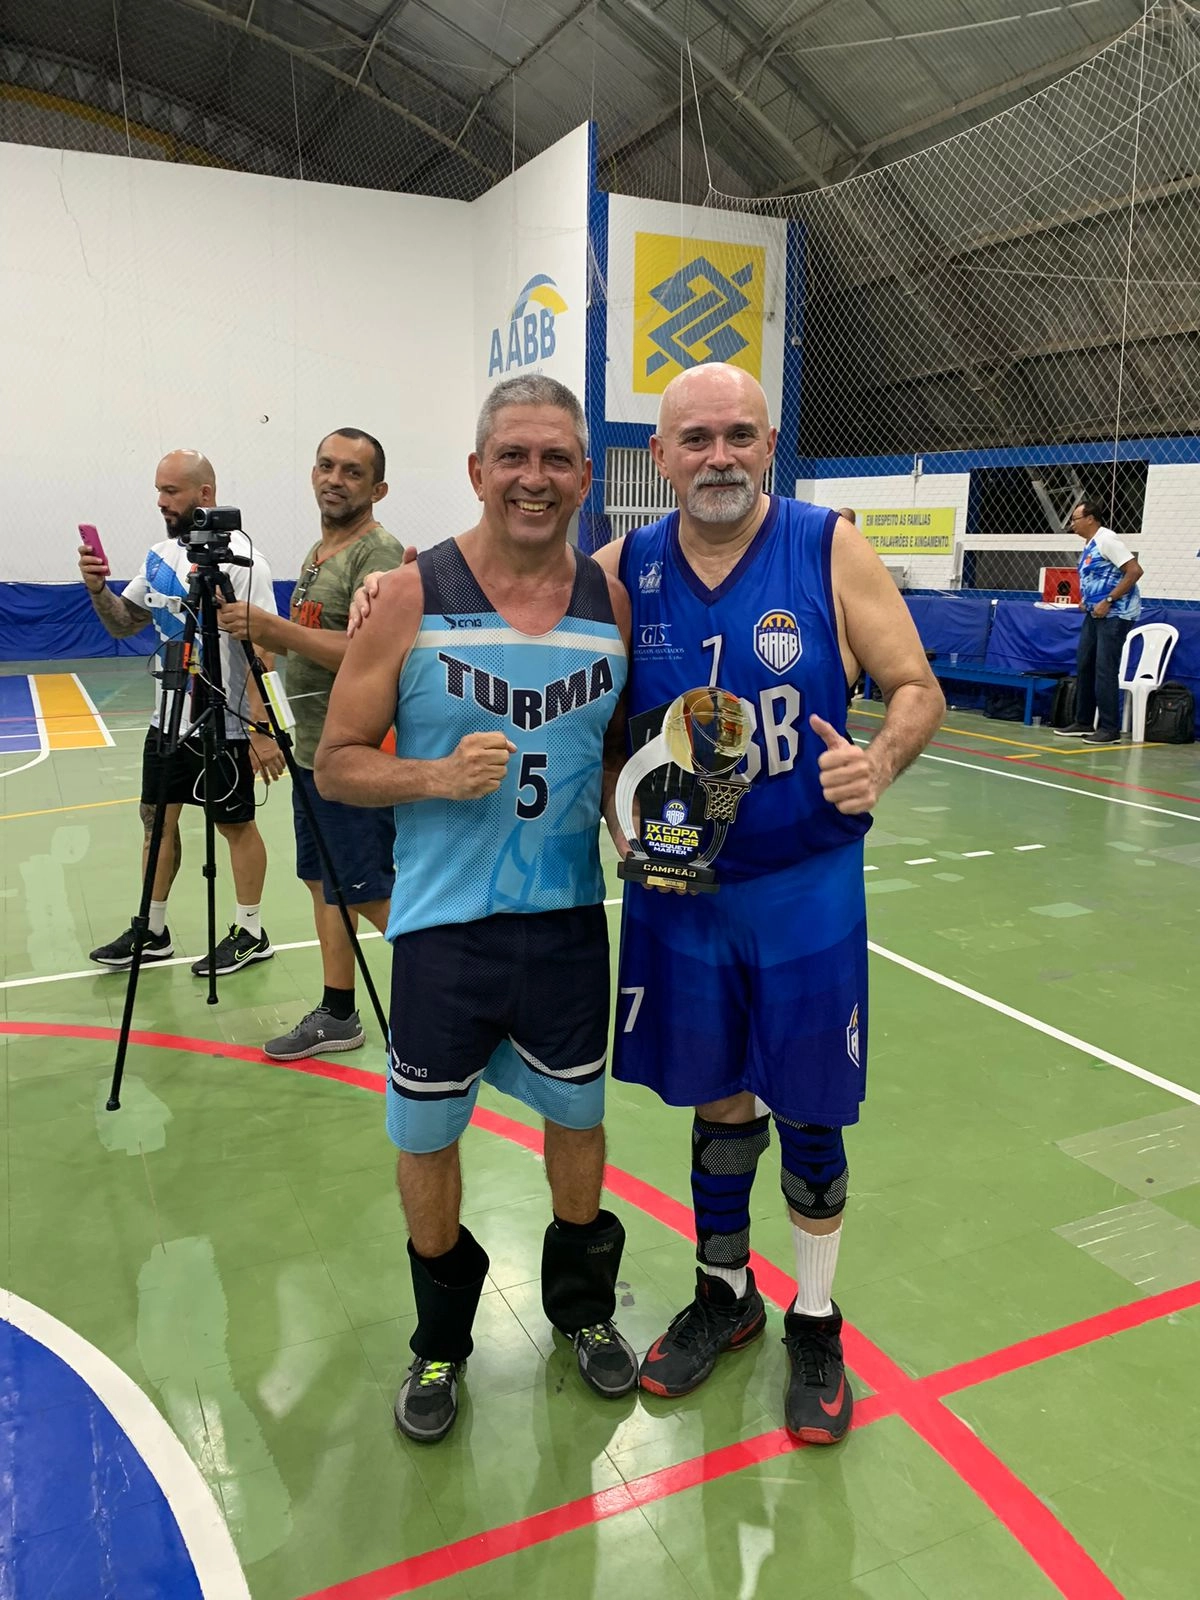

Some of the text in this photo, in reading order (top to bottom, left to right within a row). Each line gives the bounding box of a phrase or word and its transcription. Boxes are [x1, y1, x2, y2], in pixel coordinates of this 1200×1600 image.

[488, 308, 556, 377] AABB
[866, 514, 874, 526] EM
[875, 514, 898, 526] RESPEITO
[909, 535, 914, 548] E
[702, 634, 722, 687] 7
[437, 651, 614, 732] TURMA
[515, 752, 549, 820] 5
[646, 824, 699, 839] IX COPA
[648, 841, 693, 852] BASQUETE
[653, 847, 687, 856] MASTER
[643, 863, 697, 878] CAMPEÃO
[620, 986, 645, 1033] 7
